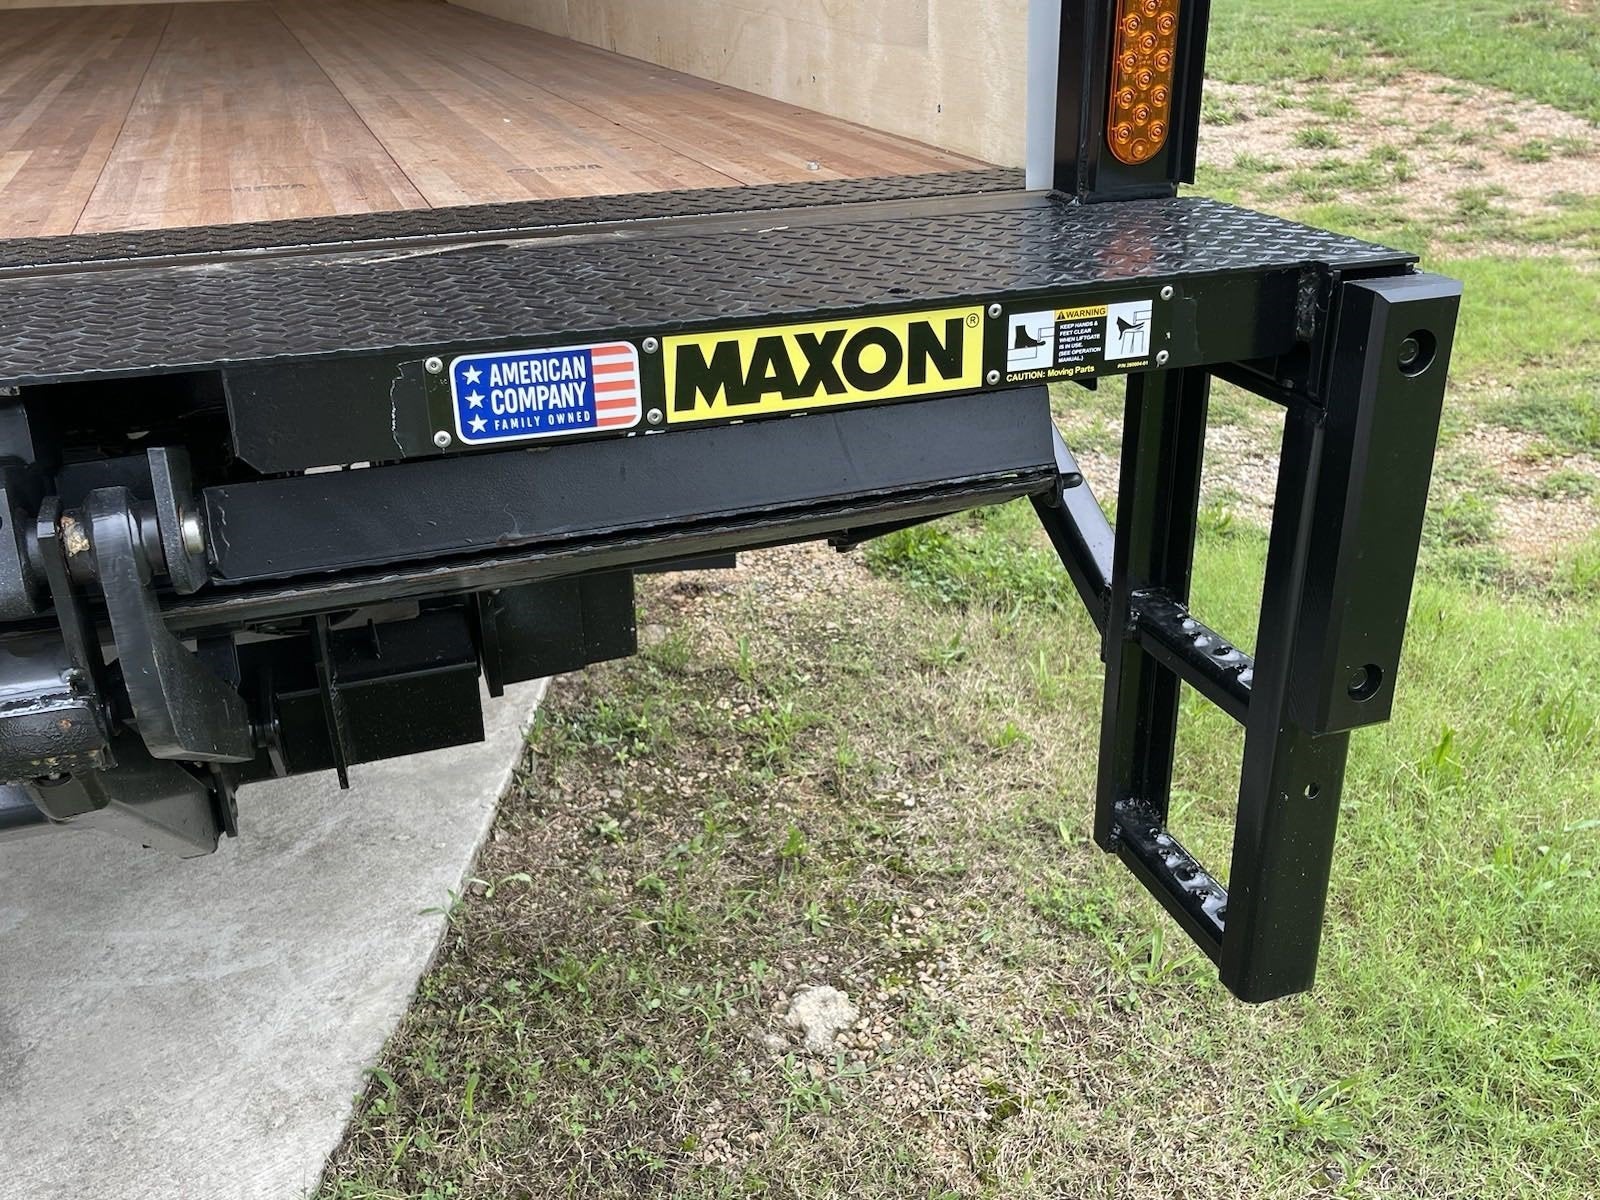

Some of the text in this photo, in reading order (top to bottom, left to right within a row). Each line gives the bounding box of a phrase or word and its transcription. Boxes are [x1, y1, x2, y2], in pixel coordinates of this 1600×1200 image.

[1065, 307, 1106, 318] WARNING
[1076, 333, 1101, 341] LIFTGATE
[1071, 347, 1102, 355] OPERATION
[489, 355, 587, 387] AMERICAN
[674, 317, 964, 412] MAXON
[1006, 364, 1095, 382] CAUTION: Moving Parts
[491, 381, 587, 415] COMPANY
[494, 410, 591, 431] FAMILY OWNED
